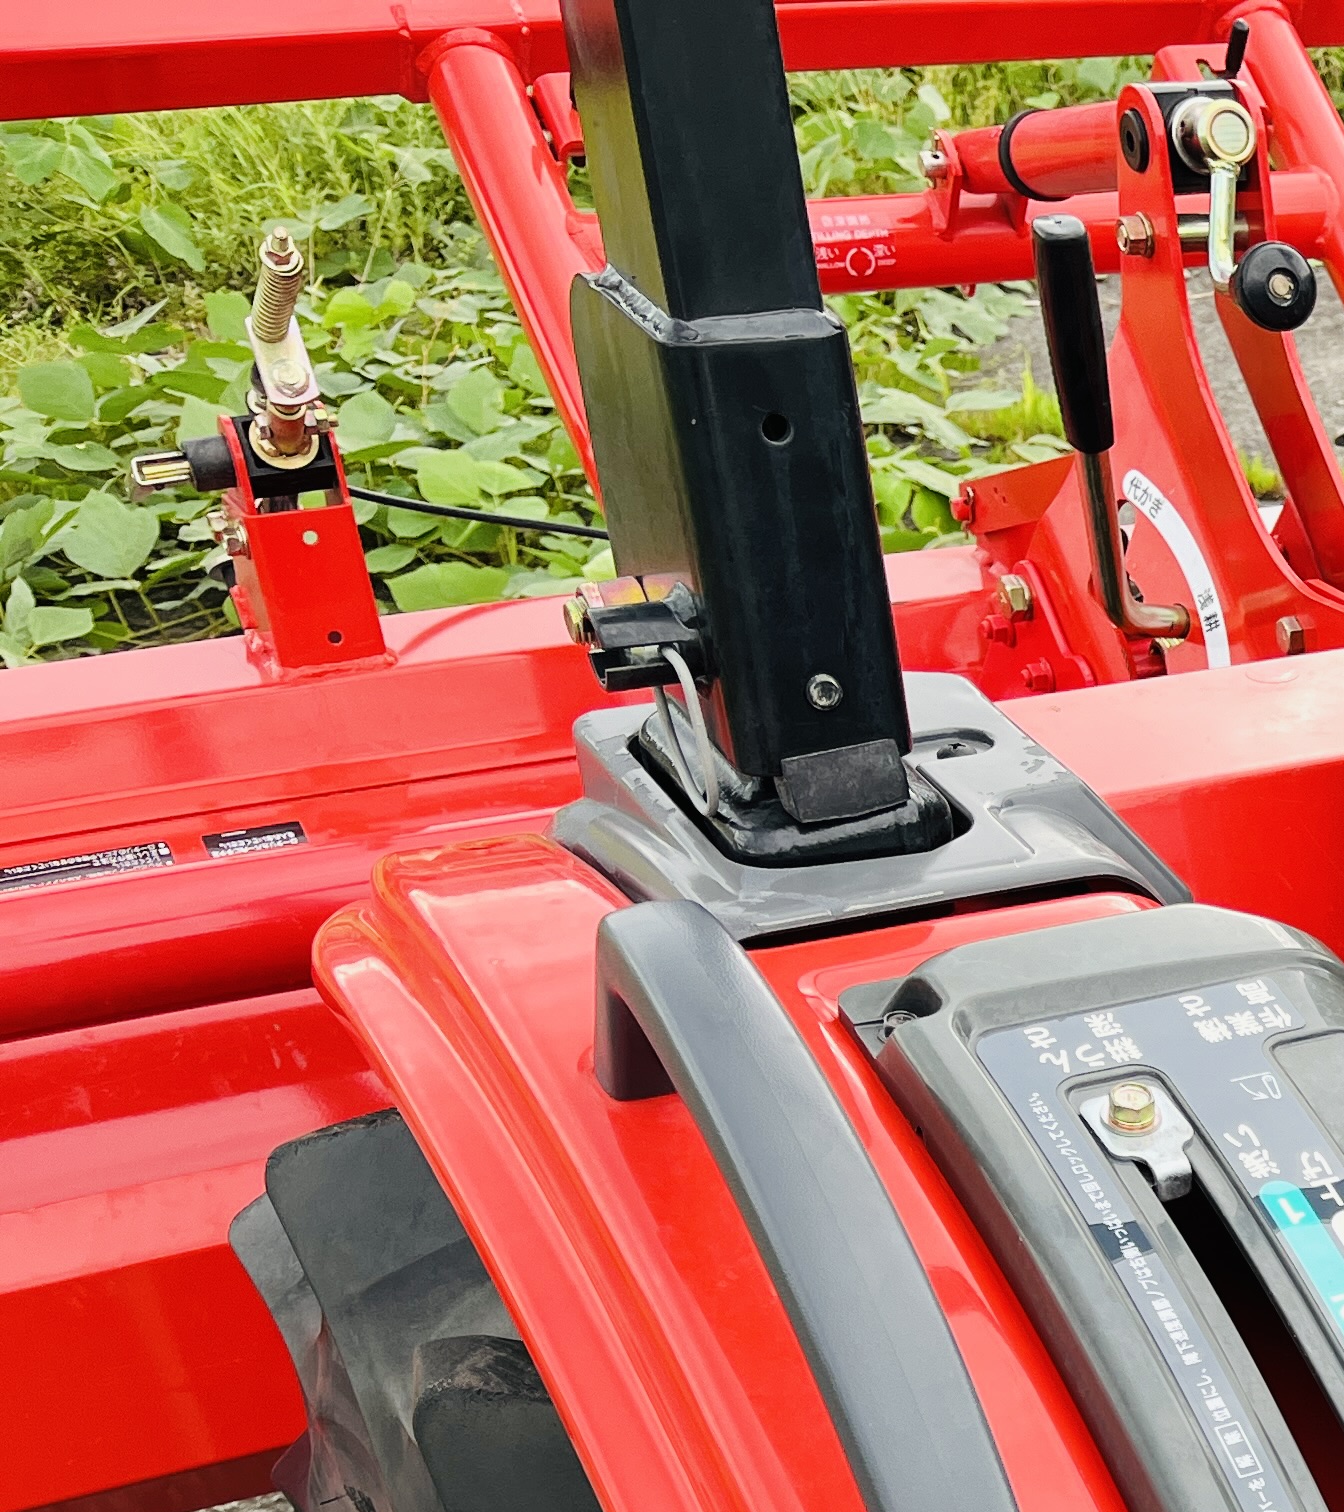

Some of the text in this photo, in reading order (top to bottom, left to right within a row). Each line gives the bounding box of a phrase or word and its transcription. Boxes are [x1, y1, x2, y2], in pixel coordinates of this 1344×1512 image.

[854, 229, 888, 239] DEPTH
[1128, 476, 1166, 520] 代かき
[1177, 976, 1274, 1020] 高さ
[1022, 1009, 1121, 1052] 深さ
[1192, 1002, 1291, 1046] 作業機
[1037, 1032, 1142, 1078] 耕うん
[1223, 1125, 1282, 1182] 浅い
[1277, 1198, 1305, 1223] 1
